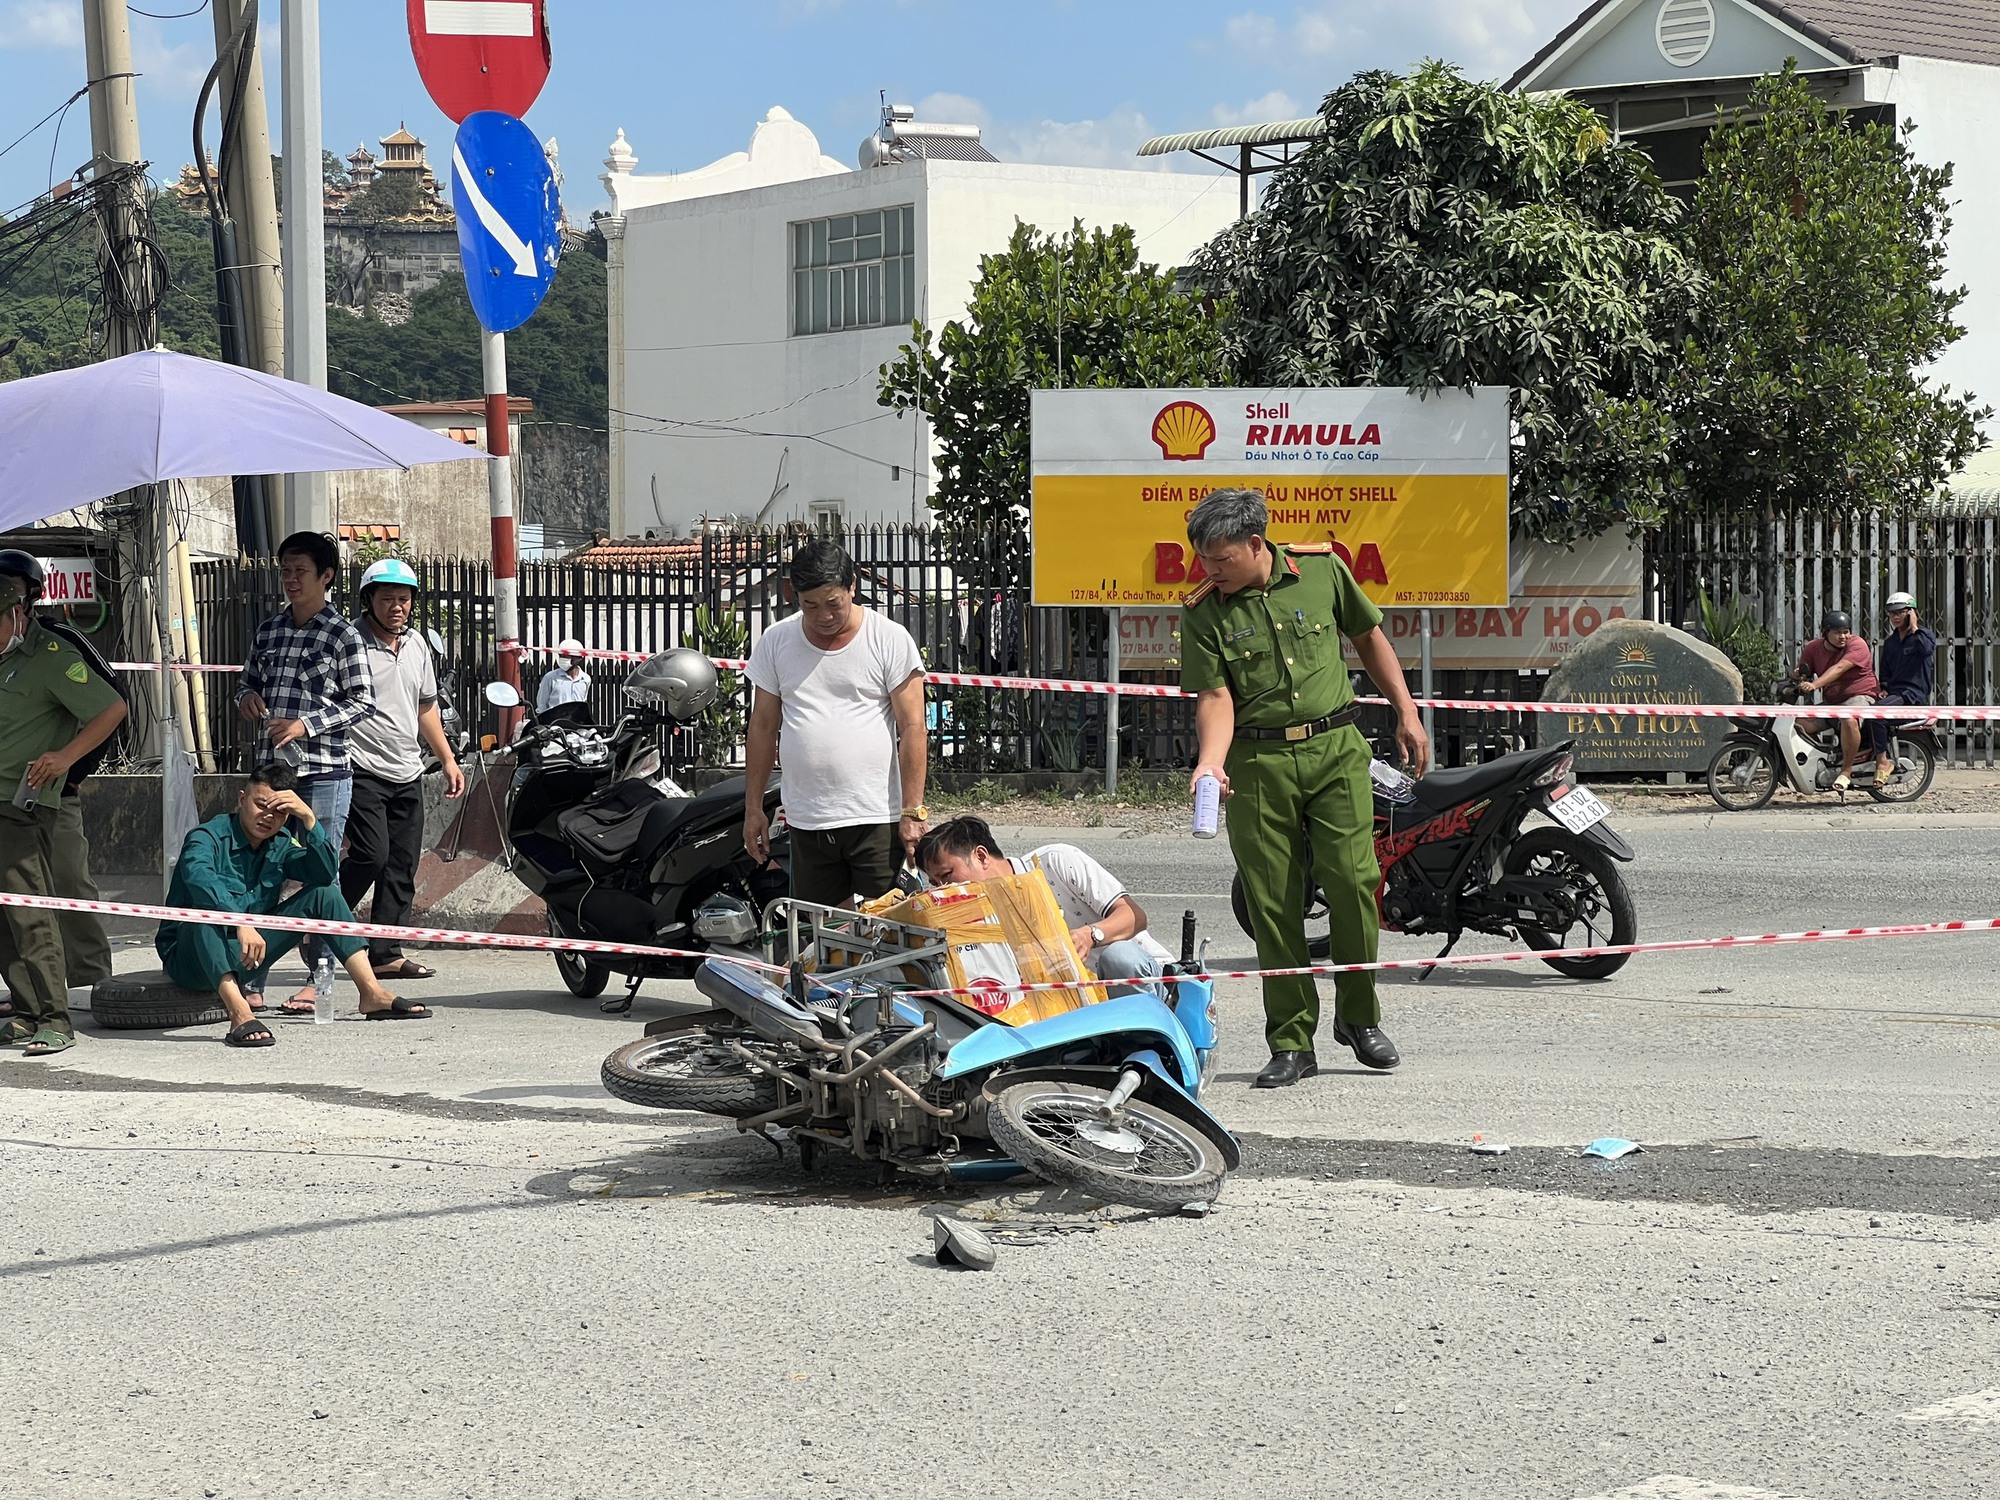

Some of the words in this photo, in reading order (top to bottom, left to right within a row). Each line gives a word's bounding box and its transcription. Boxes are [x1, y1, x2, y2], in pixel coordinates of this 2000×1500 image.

[1245, 402, 1289, 419] Shell
[1245, 423, 1382, 446] RIMULA
[1303, 448, 1312, 460] Ô
[1316, 450, 1329, 460] Tô
[1332, 450, 1354, 460] Cao
[1357, 449, 1379, 462] Cấp
[1141, 481, 1184, 502] ĐIỂM
[1349, 486, 1397, 502] SHELL
[1264, 509, 1310, 524] NHH
[1316, 509, 1351, 524] MTV
[73, 572, 94, 599] XE
[1107, 590, 1120, 600] KP.
[1395, 591, 1415, 602] MST:
[1418, 591, 1470, 602] 3702303850
[1119, 614, 1160, 638] CTY
[1455, 607, 1531, 638] BAY
[1119, 643, 1149, 655] 27/B4
[1645, 674, 1660, 686] TY
[1567, 801, 1605, 831] 032.87
